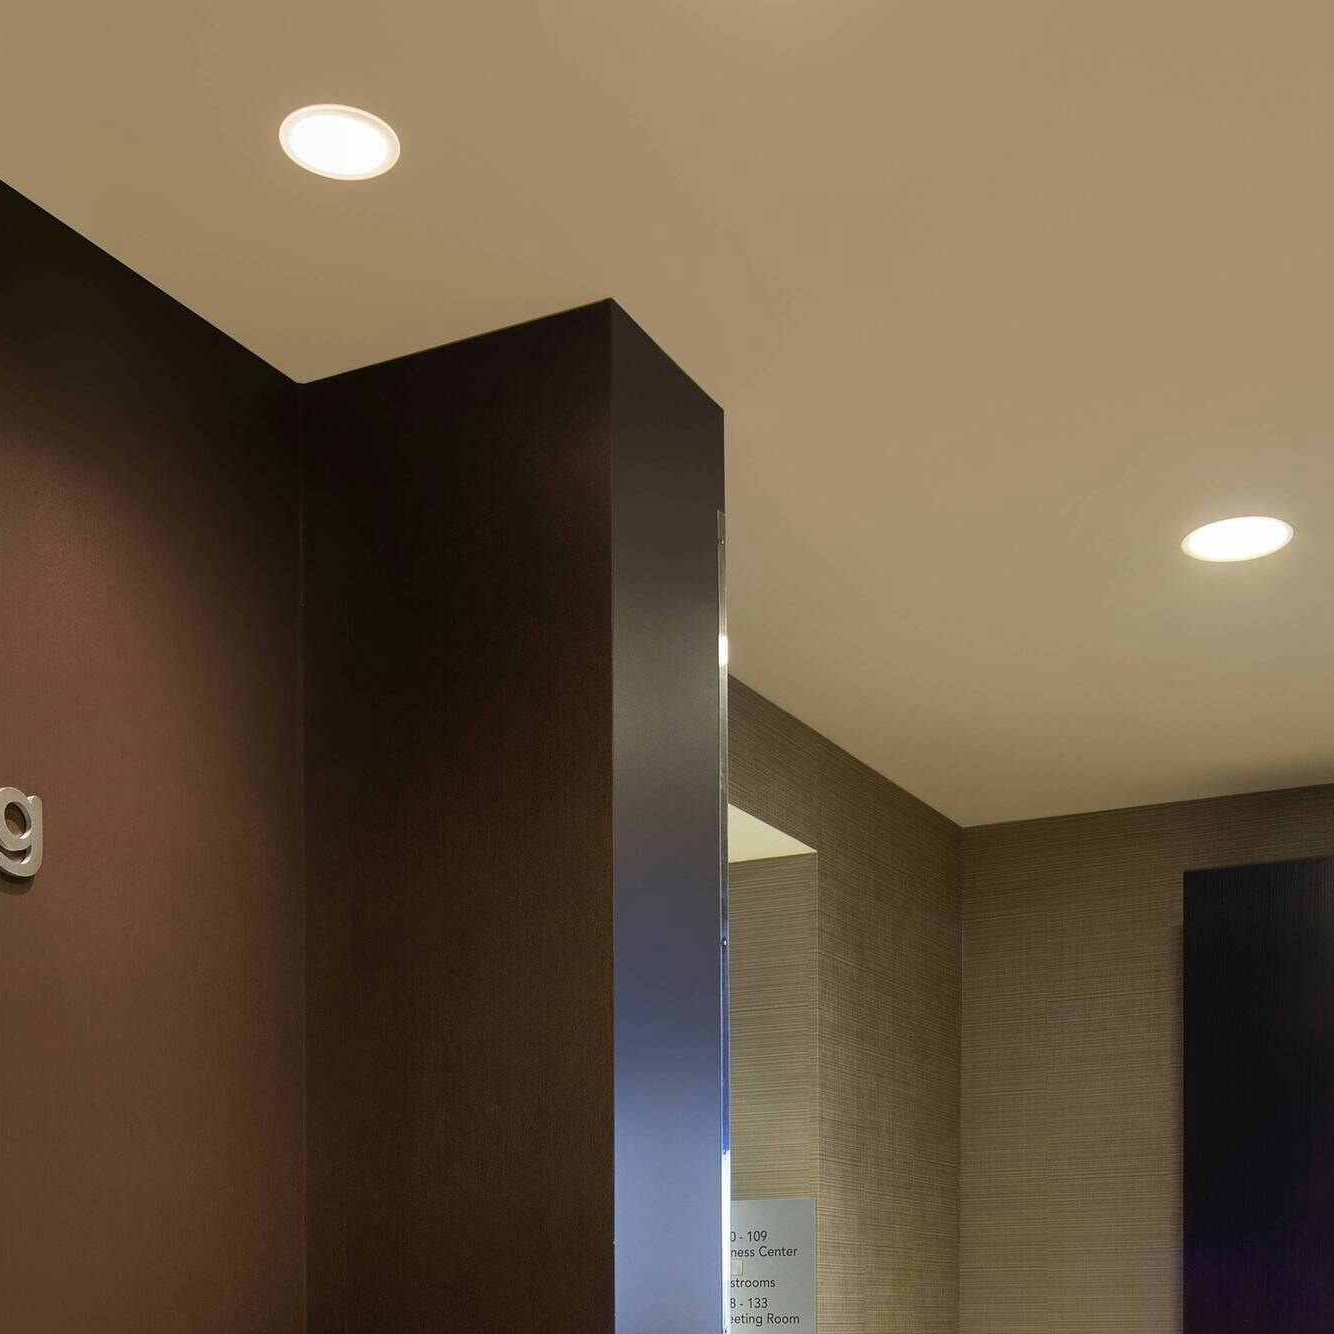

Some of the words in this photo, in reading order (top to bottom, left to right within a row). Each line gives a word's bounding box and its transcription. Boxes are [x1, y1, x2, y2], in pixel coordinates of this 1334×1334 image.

[747, 1230, 767, 1242] 109
[759, 1246, 798, 1257] Center
[748, 1297, 768, 1309] 133
[767, 1313, 800, 1324] Room
